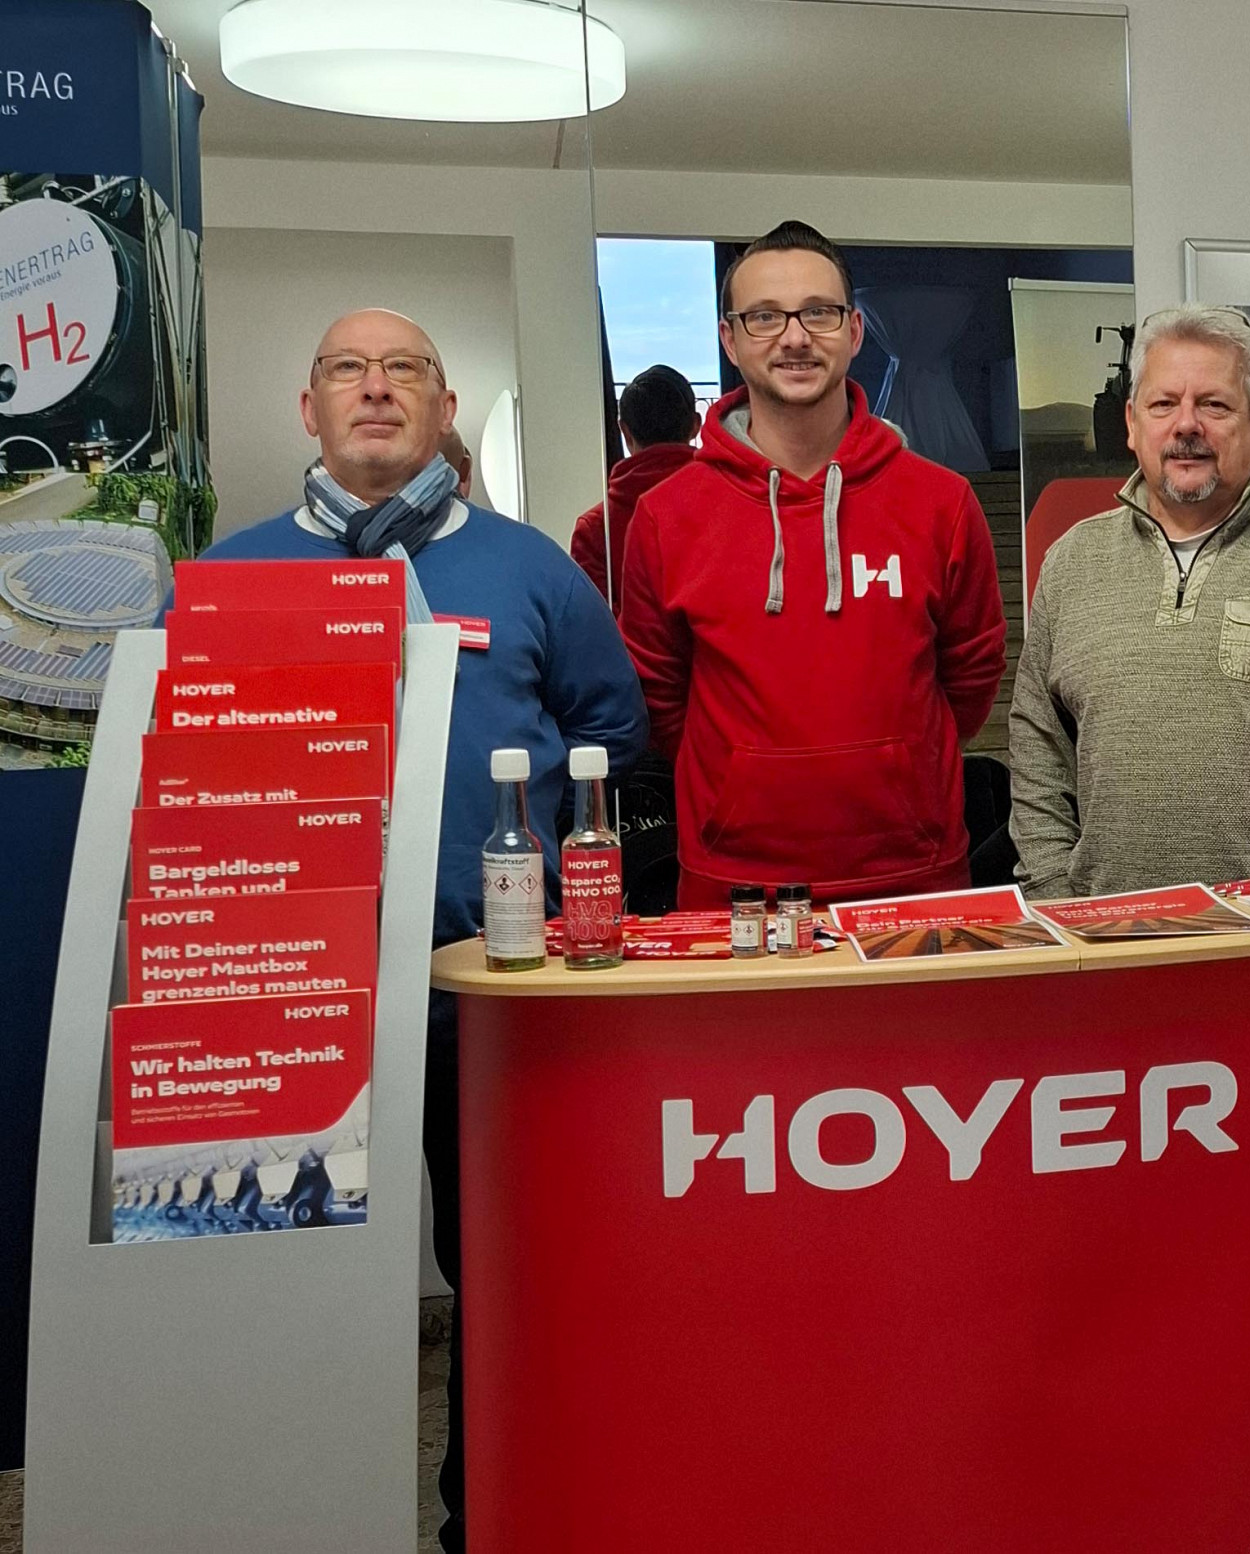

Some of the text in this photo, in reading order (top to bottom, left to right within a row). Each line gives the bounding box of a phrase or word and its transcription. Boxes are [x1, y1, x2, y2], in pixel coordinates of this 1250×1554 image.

[0, 70, 74, 100] RAG
[332, 574, 390, 585] HOYER
[852, 553, 903, 598] H
[326, 623, 385, 635] HOYER
[173, 684, 236, 696] HOYER
[172, 707, 338, 727] Der alternative
[308, 740, 369, 753] HOYER
[159, 789, 299, 806] Der Zusatz mit
[299, 812, 362, 826] HOYER
[149, 859, 300, 881] Bargeldloses
[568, 860, 608, 869] HOYER
[149, 879, 286, 898] Tanken und
[571, 878, 602, 887] spare
[572, 888, 600, 897] HVO
[141, 910, 214, 926] HOYER
[142, 940, 326, 960] Mit Deiner neuen
[142, 958, 308, 982] Hoyer Mautbox
[142, 977, 347, 1003] grenzenlos mauten
[285, 1004, 349, 1019] HOYER
[131, 1045, 344, 1076] Wir halten Technik
[131, 1076, 282, 1099] in Bewegung
[662, 1060, 1239, 1198] HOYER
